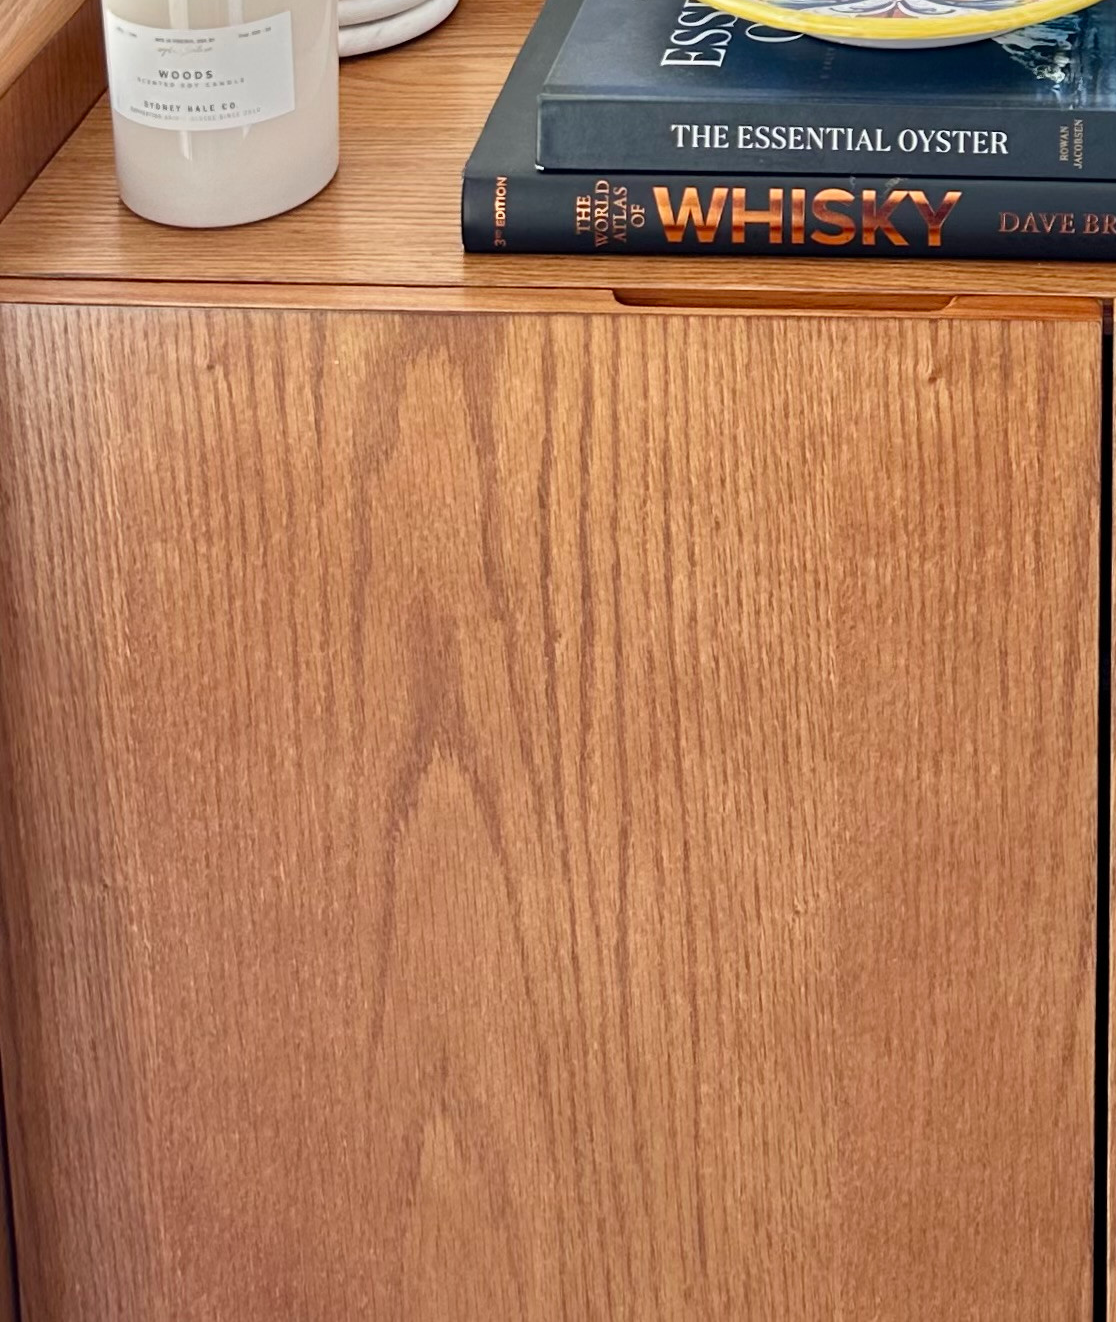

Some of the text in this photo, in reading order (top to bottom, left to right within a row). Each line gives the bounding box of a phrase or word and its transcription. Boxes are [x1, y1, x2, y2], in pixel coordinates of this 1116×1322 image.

[158, 69, 214, 80] WOODS
[143, 99, 181, 112] SYDNEY
[187, 104, 216, 113] HALE
[671, 124, 1009, 155] THE ESSENTIAL OYSTER
[1059, 126, 1070, 162] ROWAN
[1073, 119, 1084, 170] JACOBSEN
[495, 176, 508, 227] EDITION
[575, 194, 592, 235] THE
[594, 179, 611, 248] WORLD
[612, 186, 629, 244] ATLAS
[630, 204, 646, 229] OF
[652, 186, 963, 248] WHISKY
[998, 212, 1076, 234] DAVE
